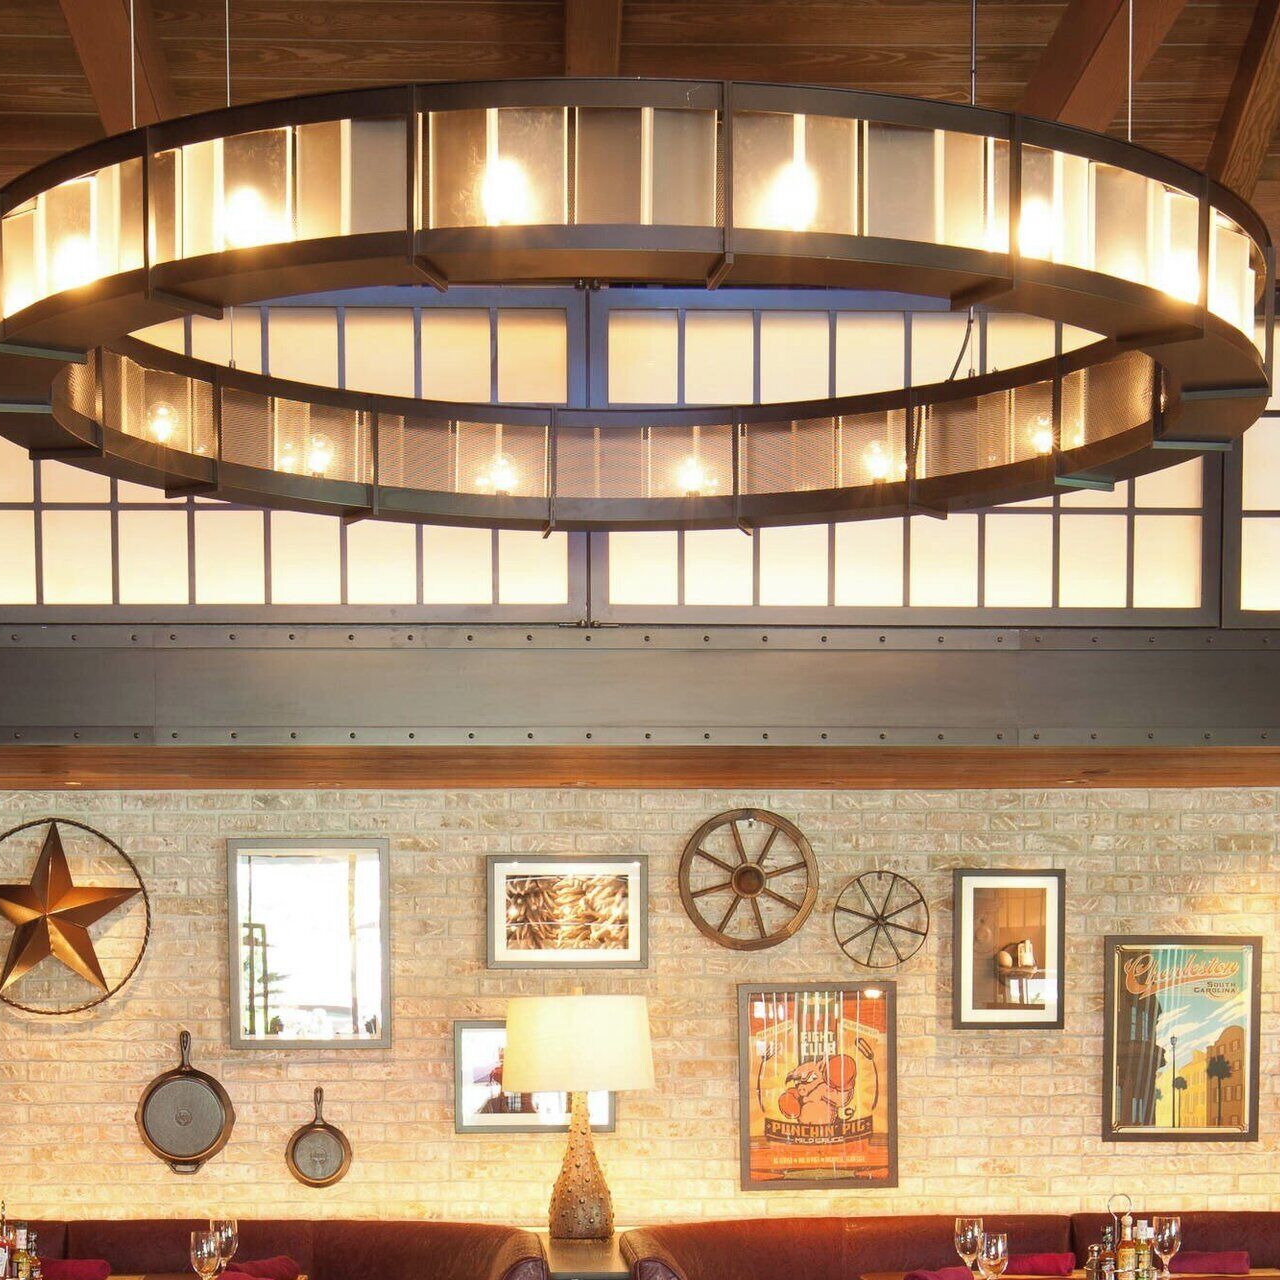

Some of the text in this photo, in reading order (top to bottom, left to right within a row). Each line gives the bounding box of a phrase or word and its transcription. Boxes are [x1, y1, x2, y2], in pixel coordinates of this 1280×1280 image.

[1124, 953, 1239, 999] Charleston
[772, 1120, 866, 1137] PUNCHIN' PIG
